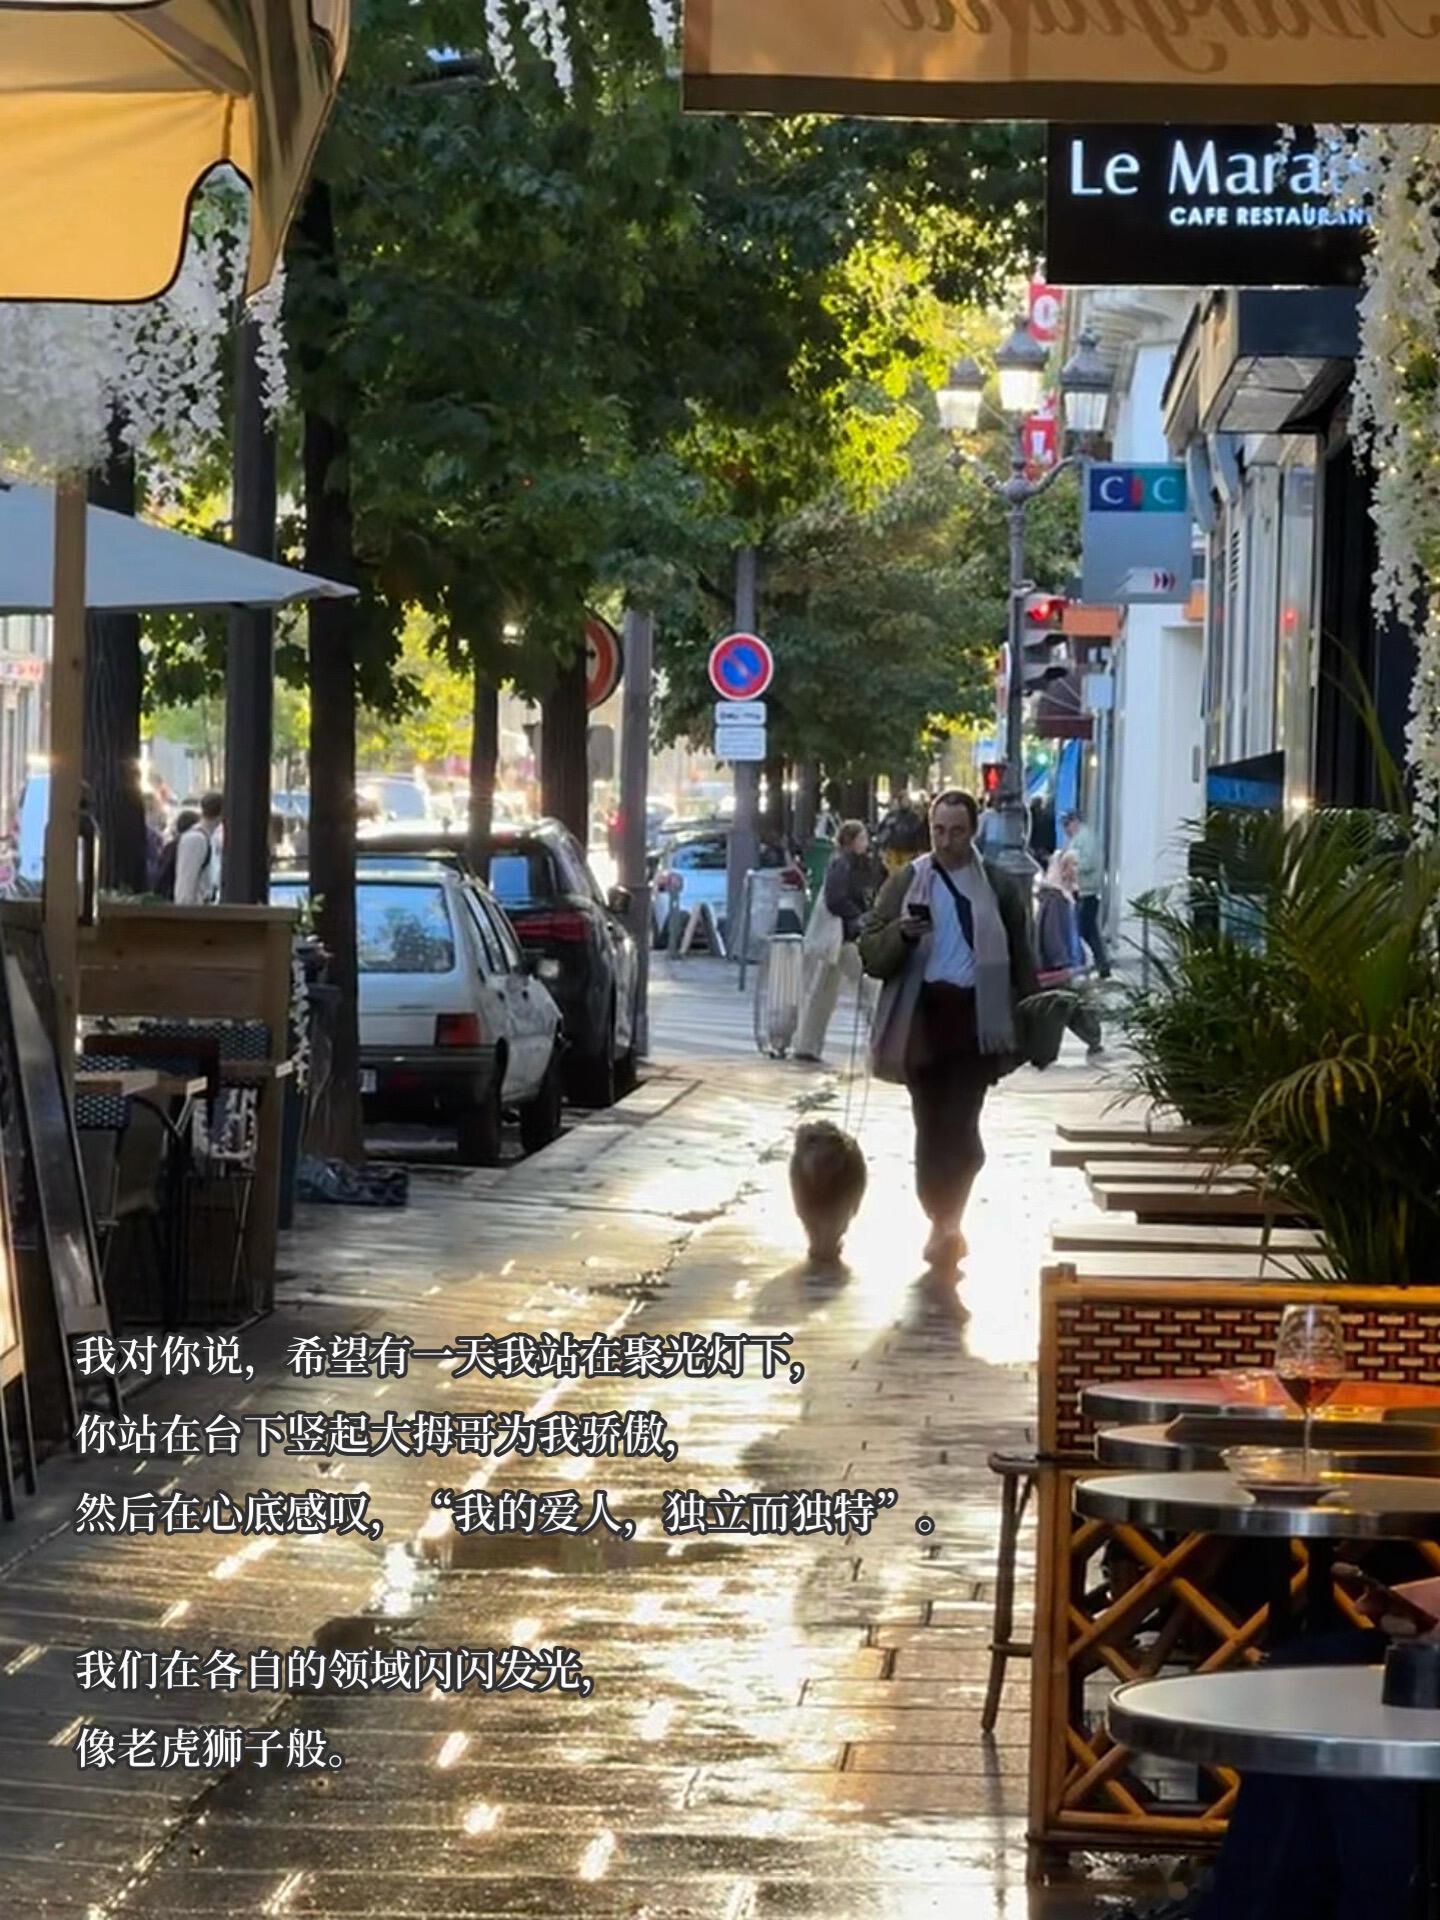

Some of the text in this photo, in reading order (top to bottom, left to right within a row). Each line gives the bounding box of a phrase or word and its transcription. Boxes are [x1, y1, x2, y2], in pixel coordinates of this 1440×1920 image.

[1070, 139, 1140, 196] Le
[1169, 206, 1227, 227] CAFE
[1100, 475, 1177, 505] CIC
